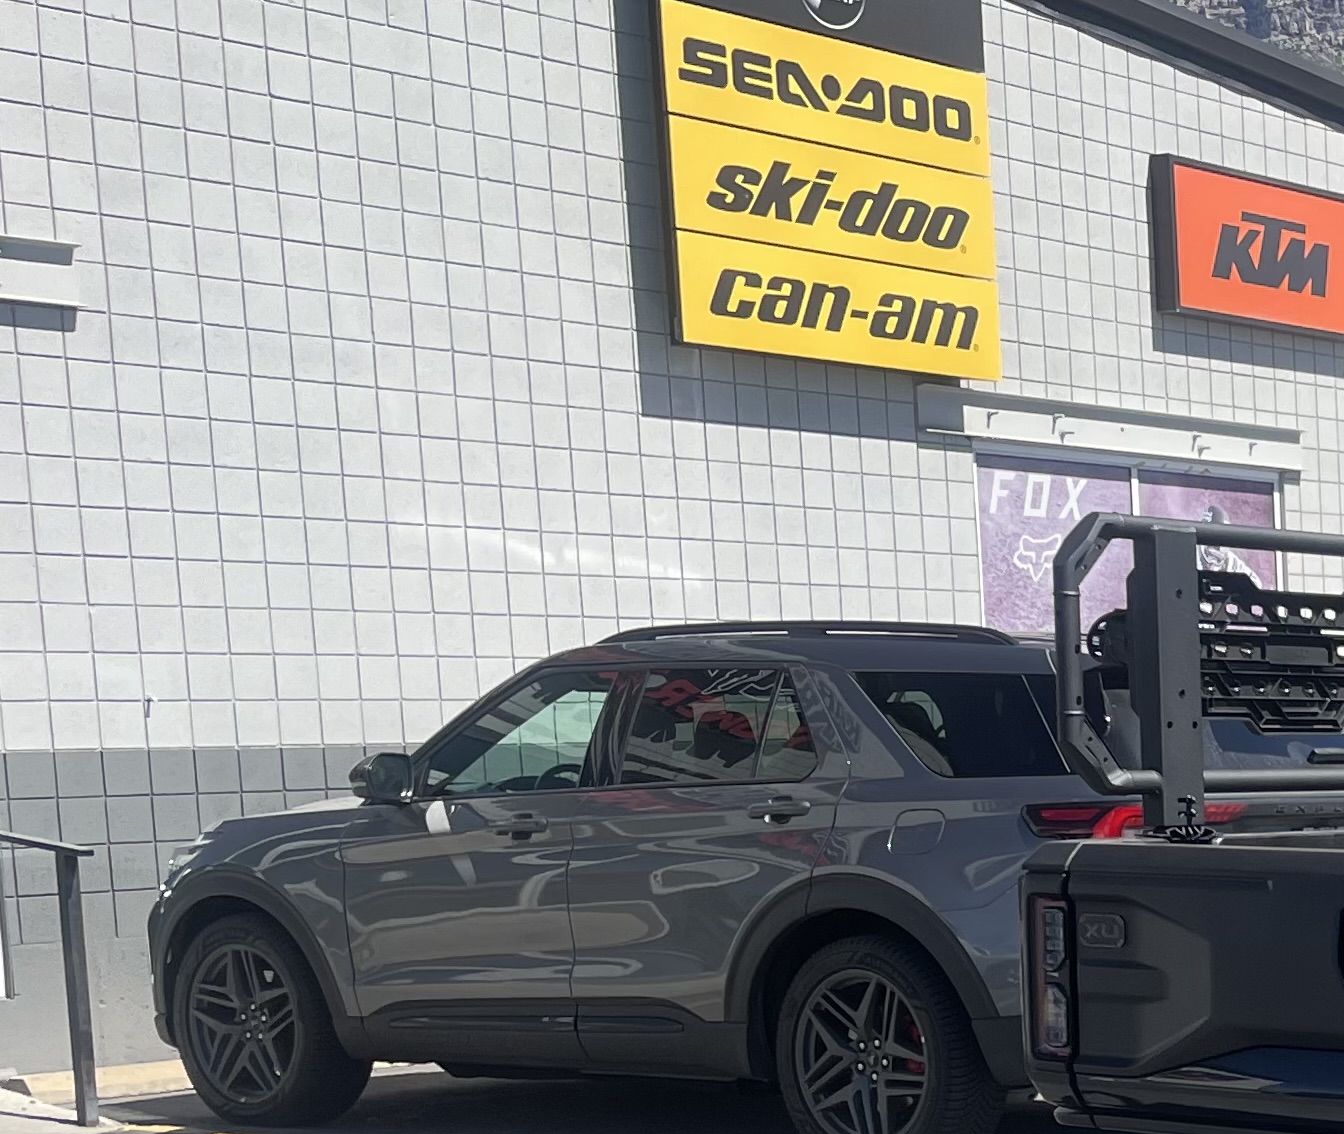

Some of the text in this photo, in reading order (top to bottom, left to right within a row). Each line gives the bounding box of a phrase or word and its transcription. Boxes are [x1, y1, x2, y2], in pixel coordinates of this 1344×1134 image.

[706, 160, 970, 250] ski-doo
[1212, 211, 1329, 298] KTM
[710, 268, 979, 350] can-am
[989, 471, 1088, 521] FOX
